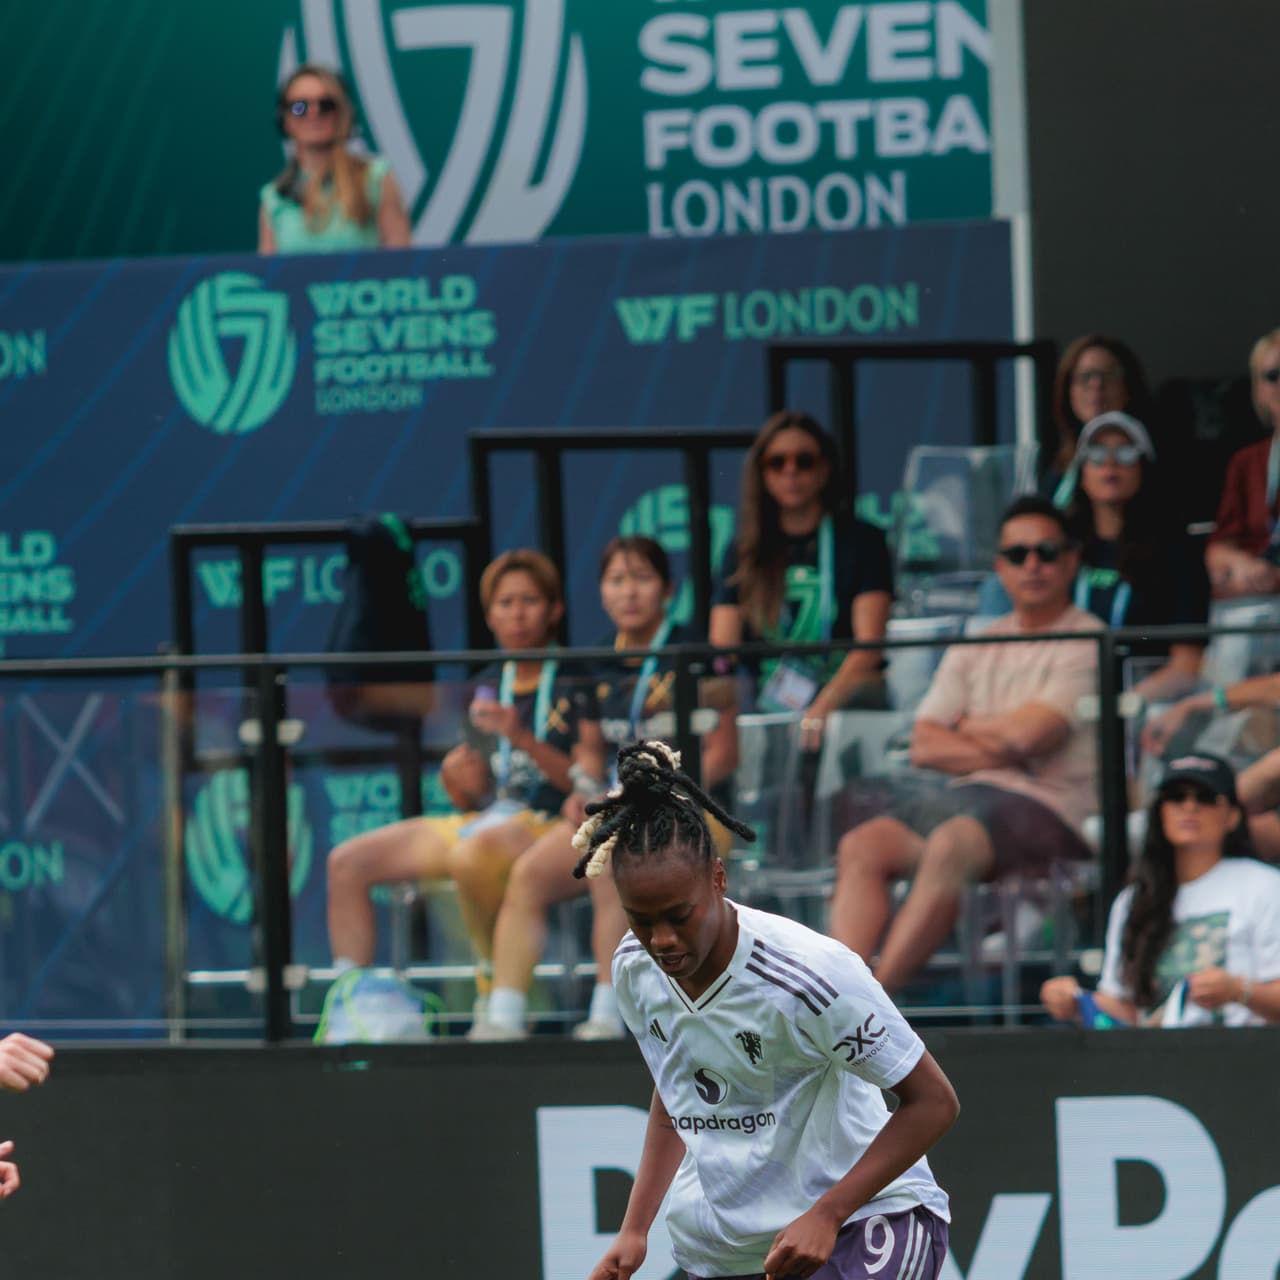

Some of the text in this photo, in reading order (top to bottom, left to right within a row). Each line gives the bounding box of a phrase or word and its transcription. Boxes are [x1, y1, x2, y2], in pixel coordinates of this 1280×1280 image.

[643, 94, 991, 170] FOOTBA
[646, 171, 908, 238] LONDON
[306, 274, 477, 318] WORLD
[724, 282, 919, 340] LONDON
[313, 309, 497, 353] SEVENS
[314, 350, 496, 384] FOOTBALL
[832, 1012, 886, 1063] DXC
[671, 1111, 777, 1135] napdragon
[863, 1214, 895, 1275] 9
